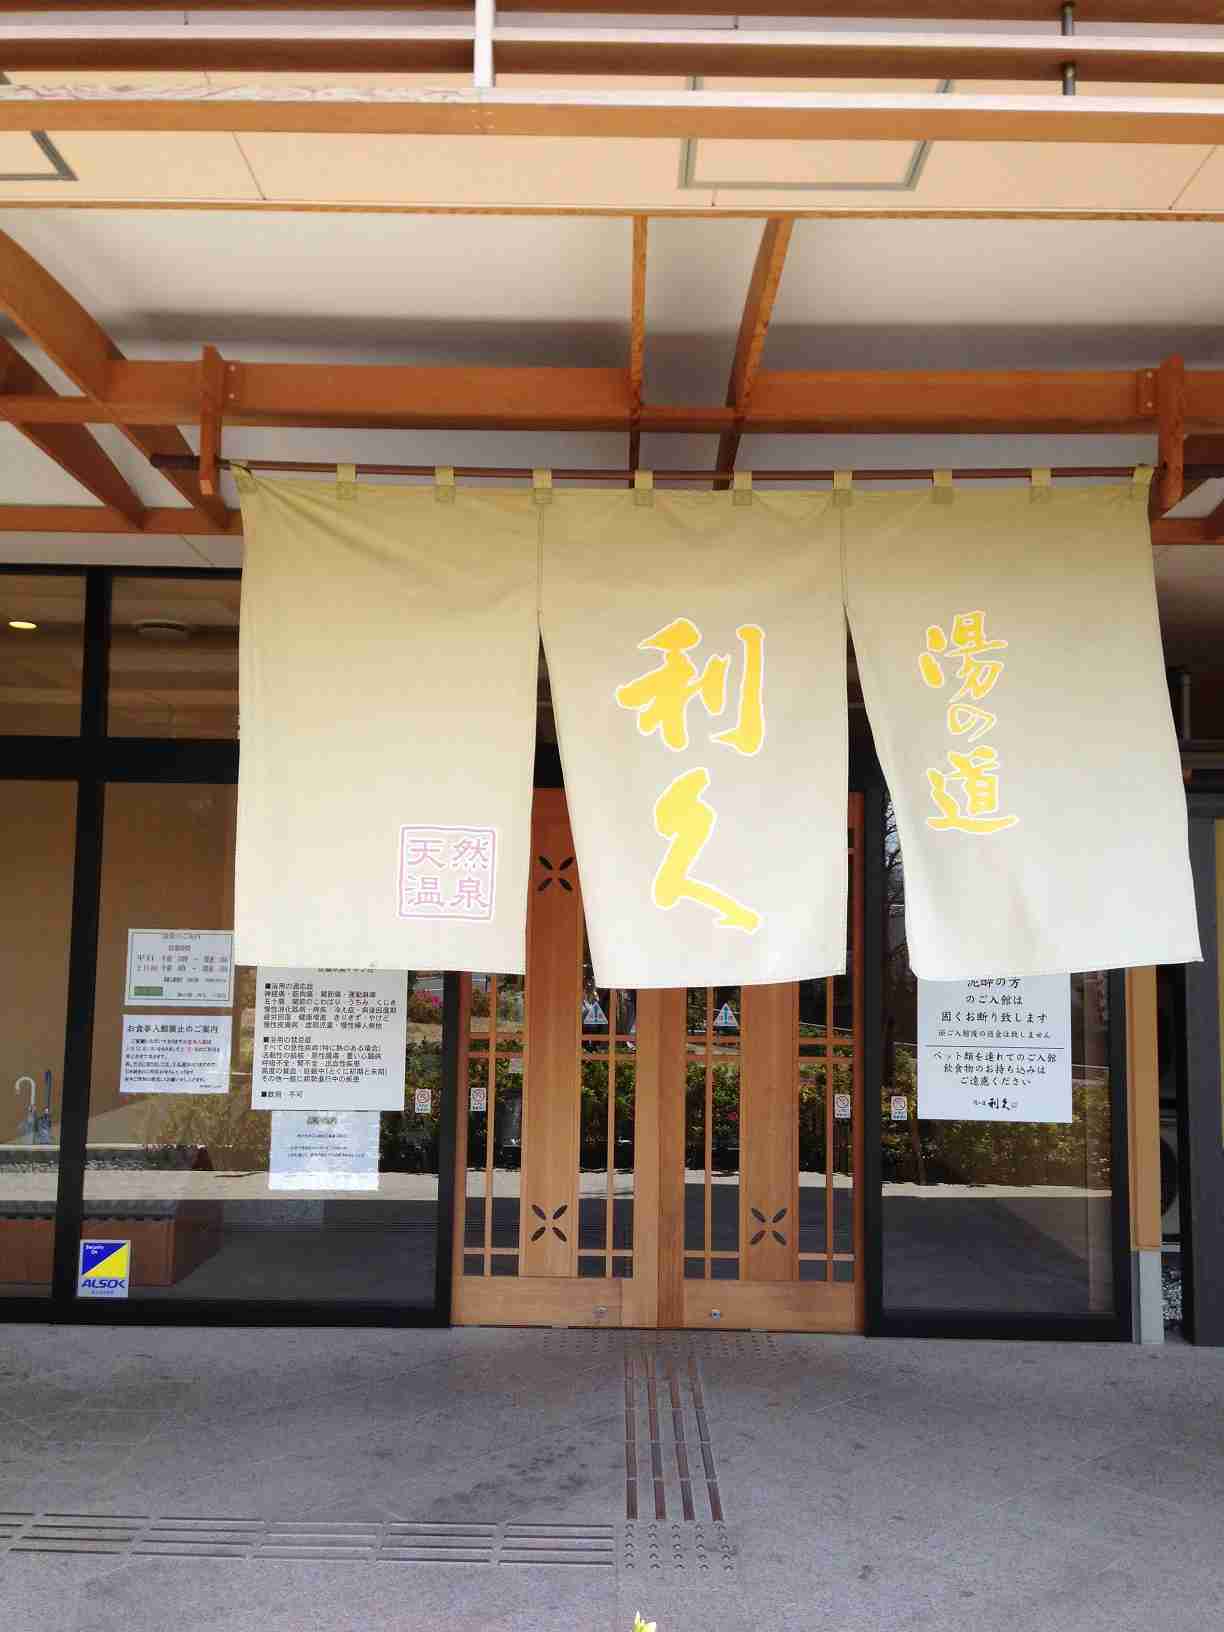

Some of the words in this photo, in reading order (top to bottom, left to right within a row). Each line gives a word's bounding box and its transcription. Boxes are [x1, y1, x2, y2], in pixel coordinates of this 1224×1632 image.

[918, 610, 1020, 834] 湯の道
[614, 617, 766, 935] 利久
[407, 838, 490, 869] 天然
[404, 876, 490, 908] 温泉
[966, 994, 1023, 1006] のご入館は
[941, 1011, 1048, 1023] 固くお断り致します
[933, 1050, 1058, 1063] ペット類を連れてのご入館
[943, 1063, 1048, 1075] 飲食物のお持ち込みは
[960, 1076, 1032, 1087] ご遠慮ください
[81, 1279, 126, 1289] ALSOK
